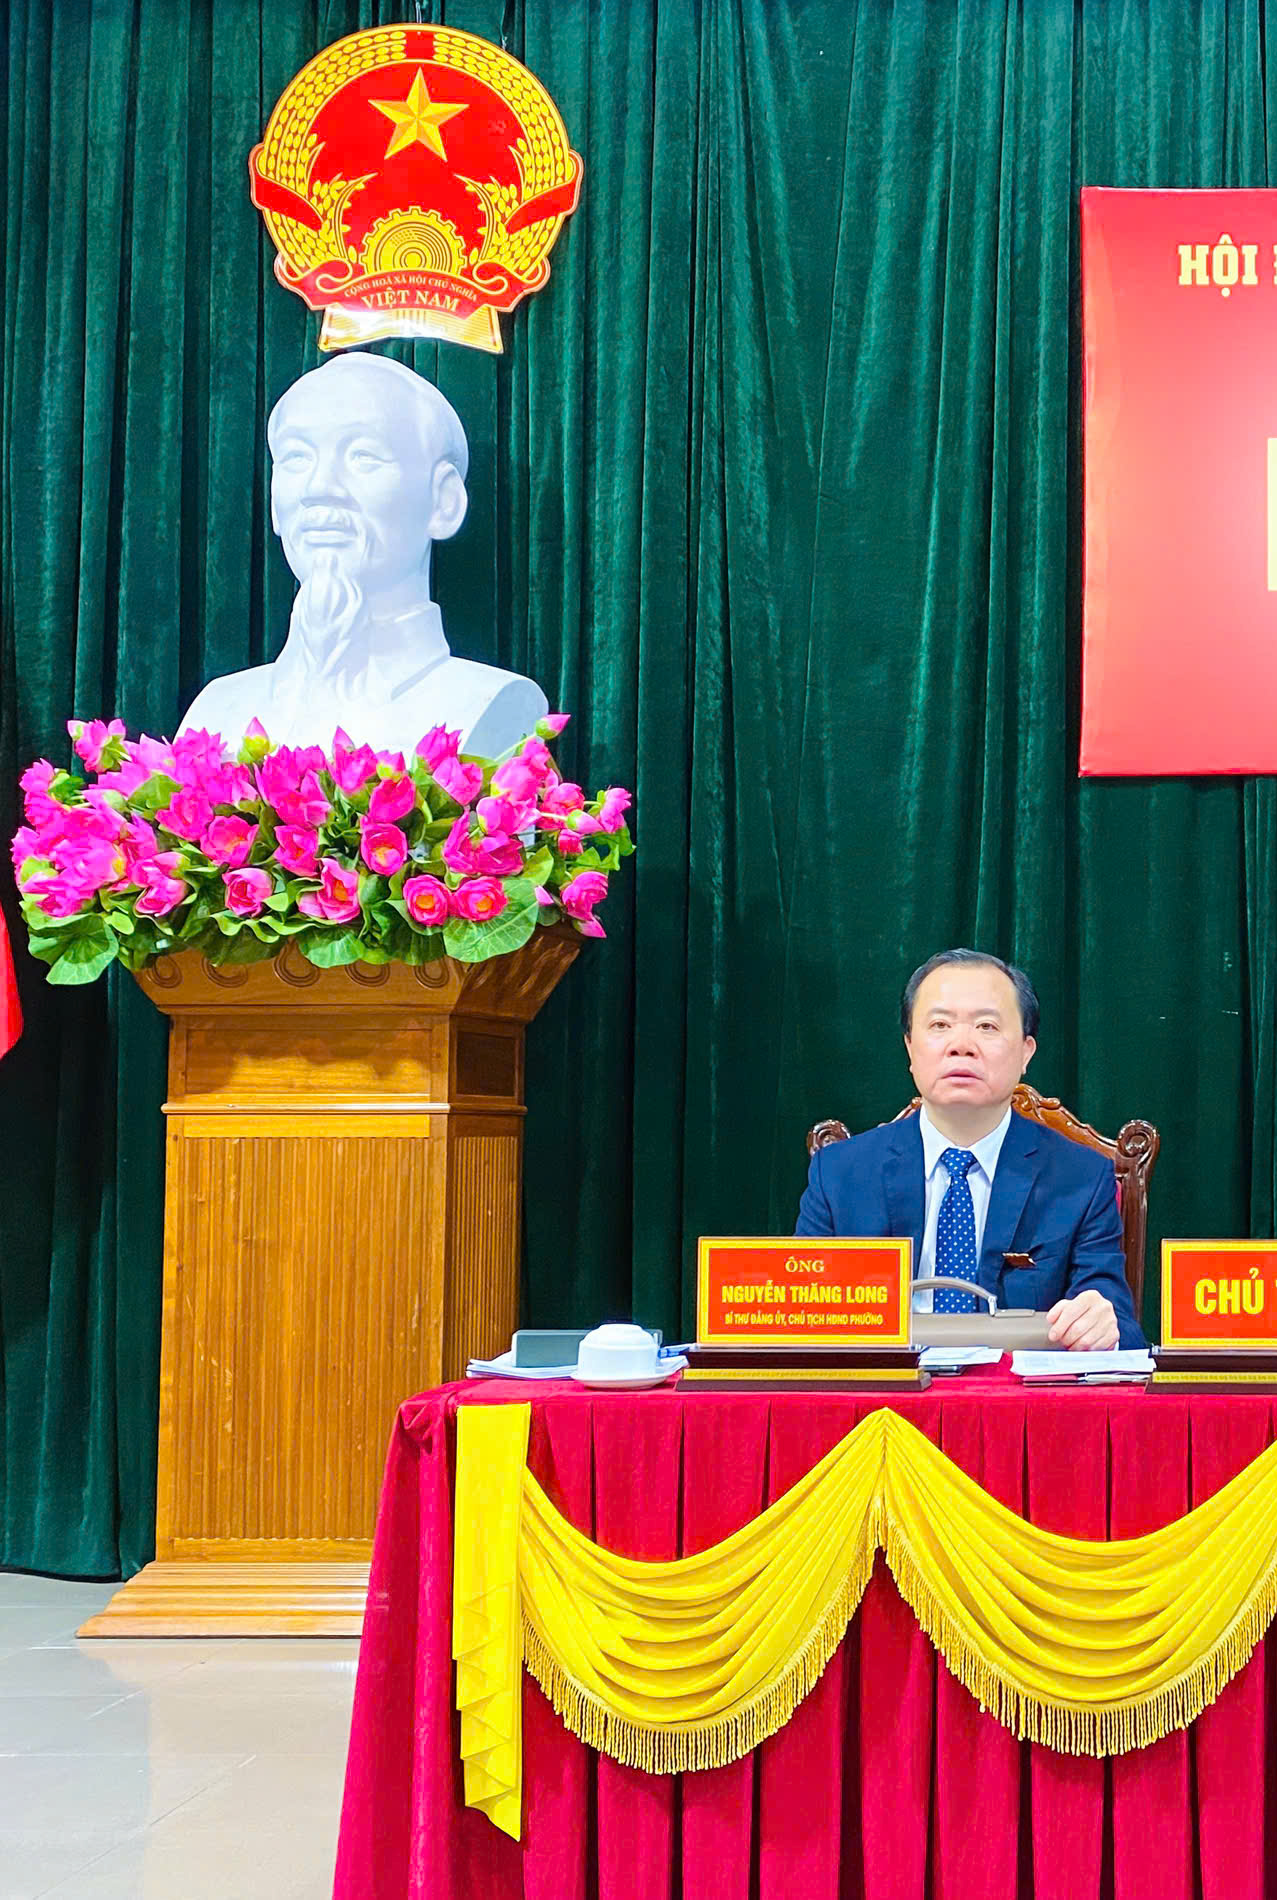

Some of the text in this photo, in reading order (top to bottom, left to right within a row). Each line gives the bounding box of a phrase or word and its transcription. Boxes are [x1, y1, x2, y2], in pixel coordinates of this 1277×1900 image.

[1178, 234, 1258, 297] HỘI
[361, 286, 460, 312] VIỆT NAM
[785, 1256, 825, 1273] ÔNG
[721, 1280, 888, 1304] NGUYỄN THĂNG LONG
[1194, 1267, 1265, 1315] CHỦ
[734, 1312, 750, 1325] THƯ
[751, 1310, 774, 1325] ĐẢNG
[788, 1310, 805, 1325] CHỦ
[806, 1313, 825, 1327] TỊCH
[826, 1313, 849, 1325] HĐND
[849, 1311, 884, 1326] PHƯỜNG
